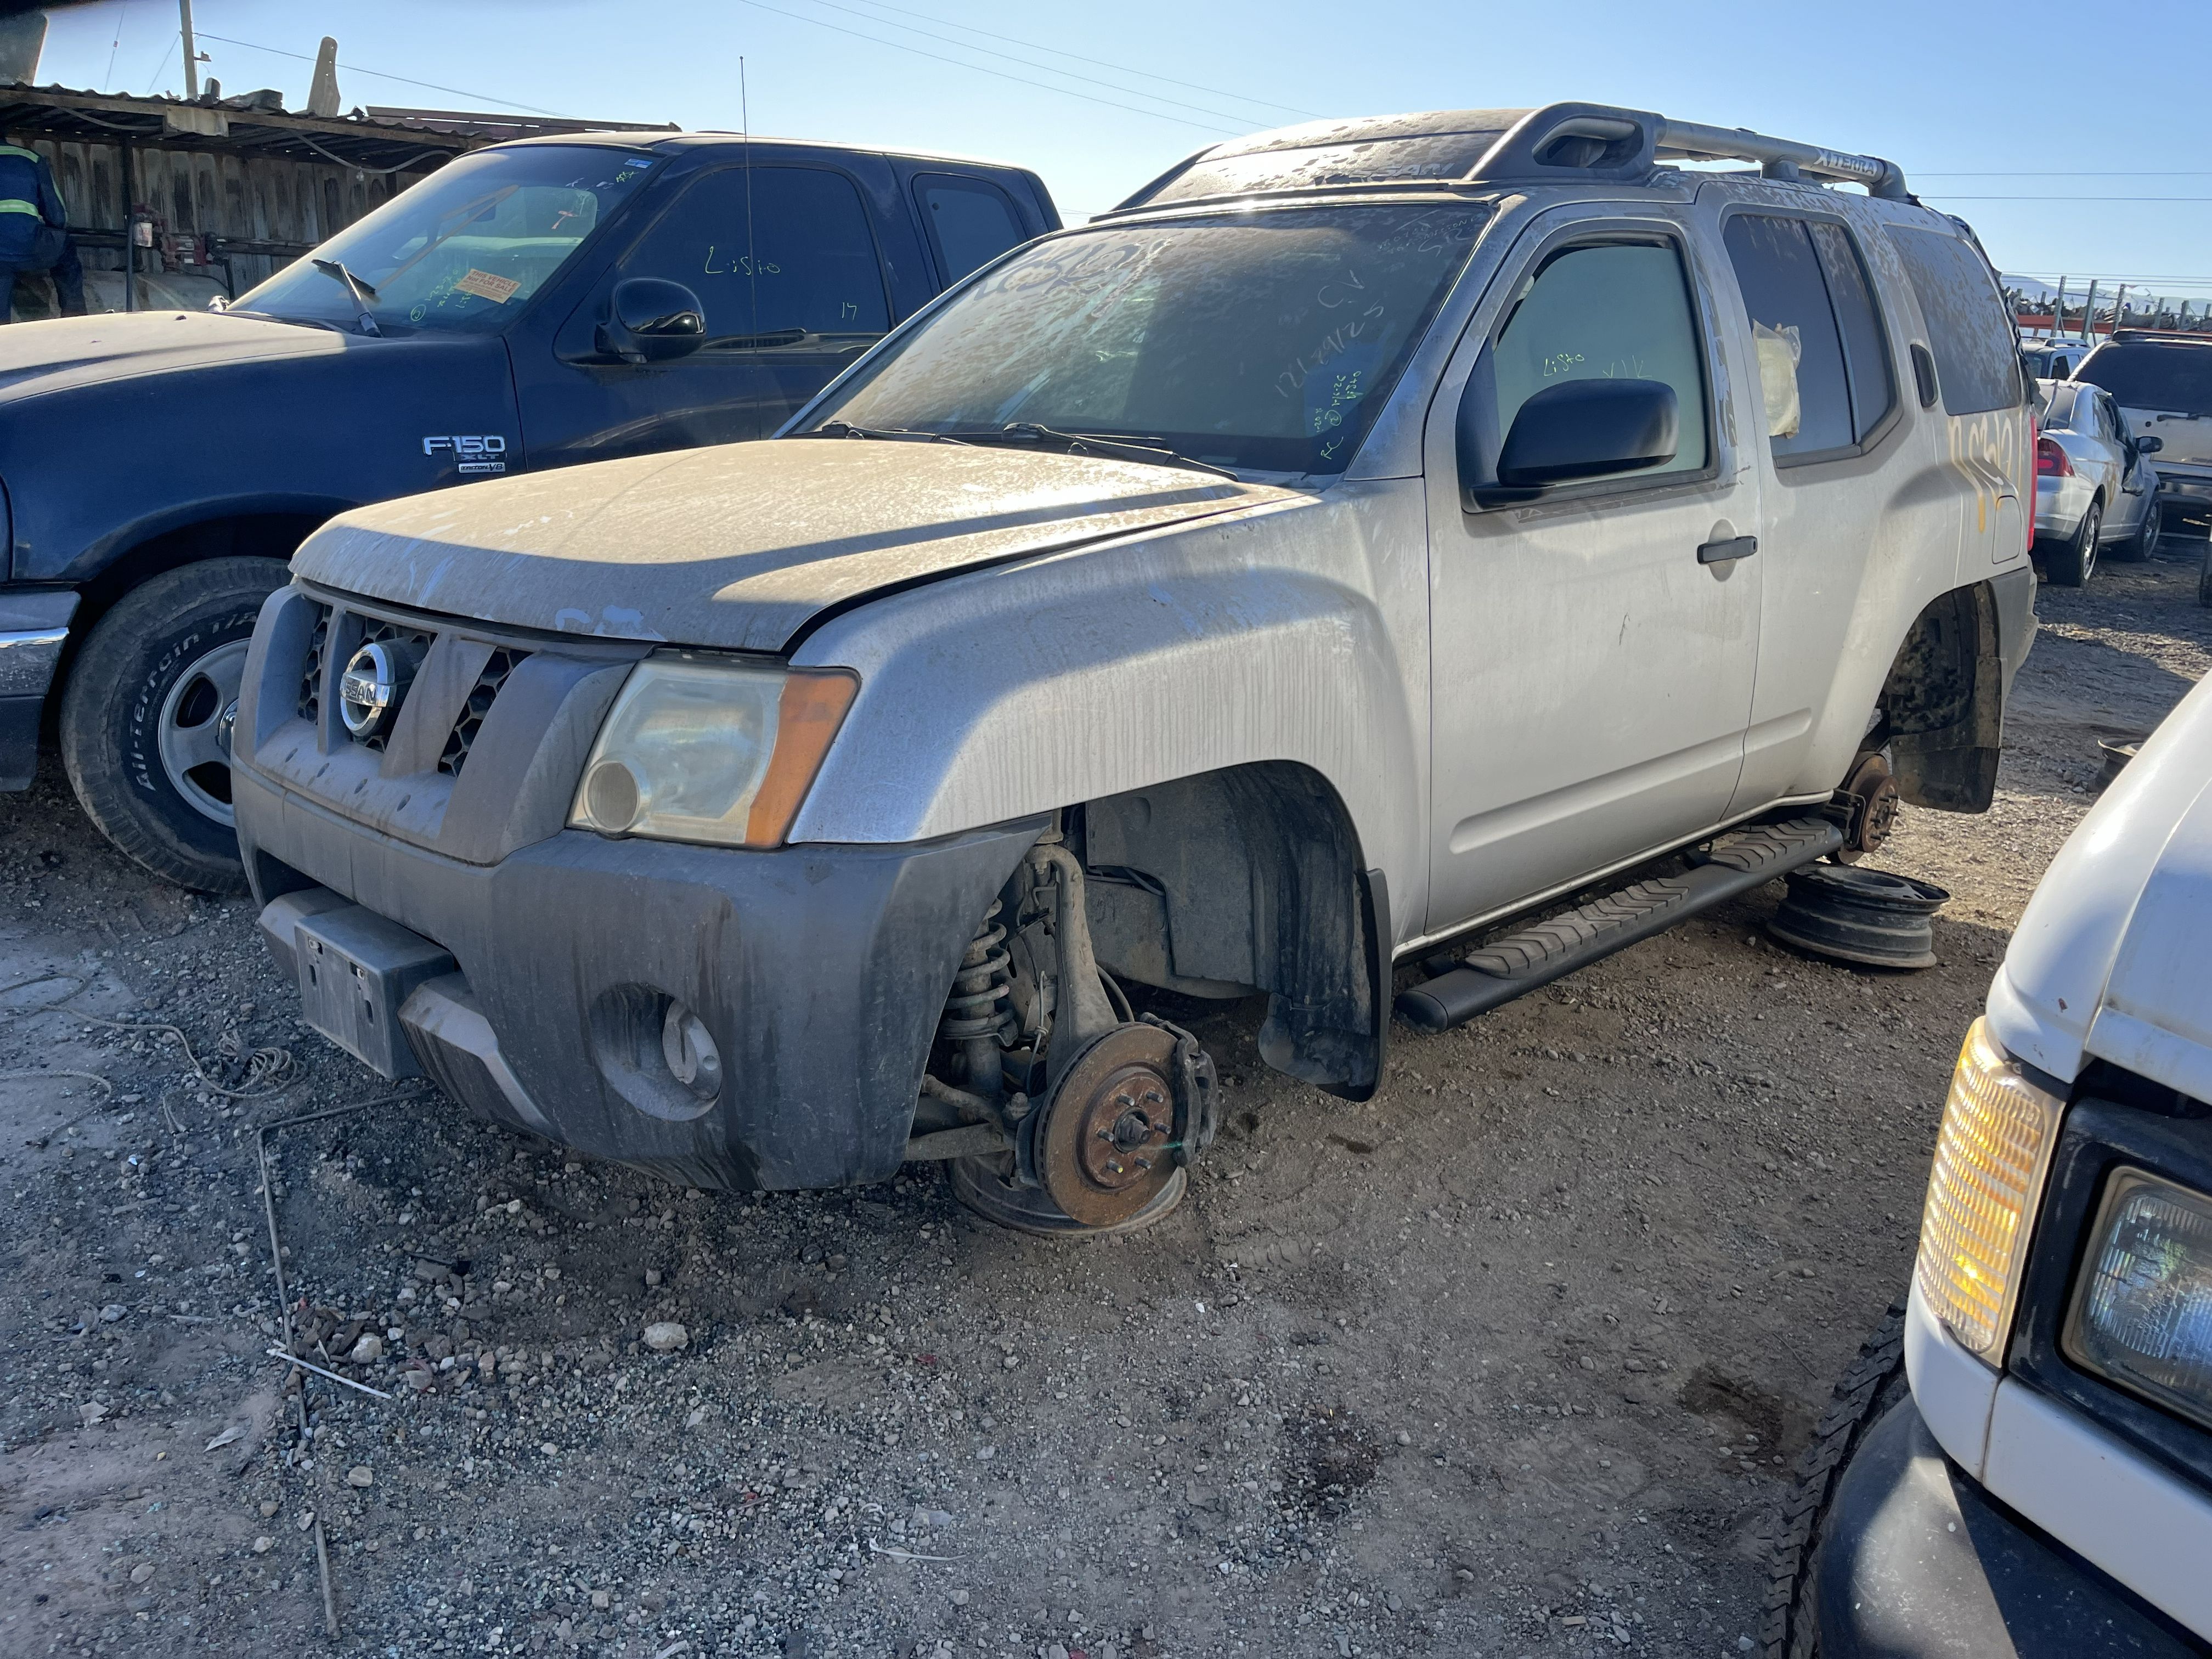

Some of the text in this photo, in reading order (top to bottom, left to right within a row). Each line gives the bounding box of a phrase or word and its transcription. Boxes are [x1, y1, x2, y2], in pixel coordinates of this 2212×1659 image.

[1813, 147, 1877, 176] XTERRA
[471, 270, 518, 287] THIS VEHICLE
[478, 278, 494, 287] FOR
[494, 283, 516, 293] SALE
[489, 464, 503, 472] V8
